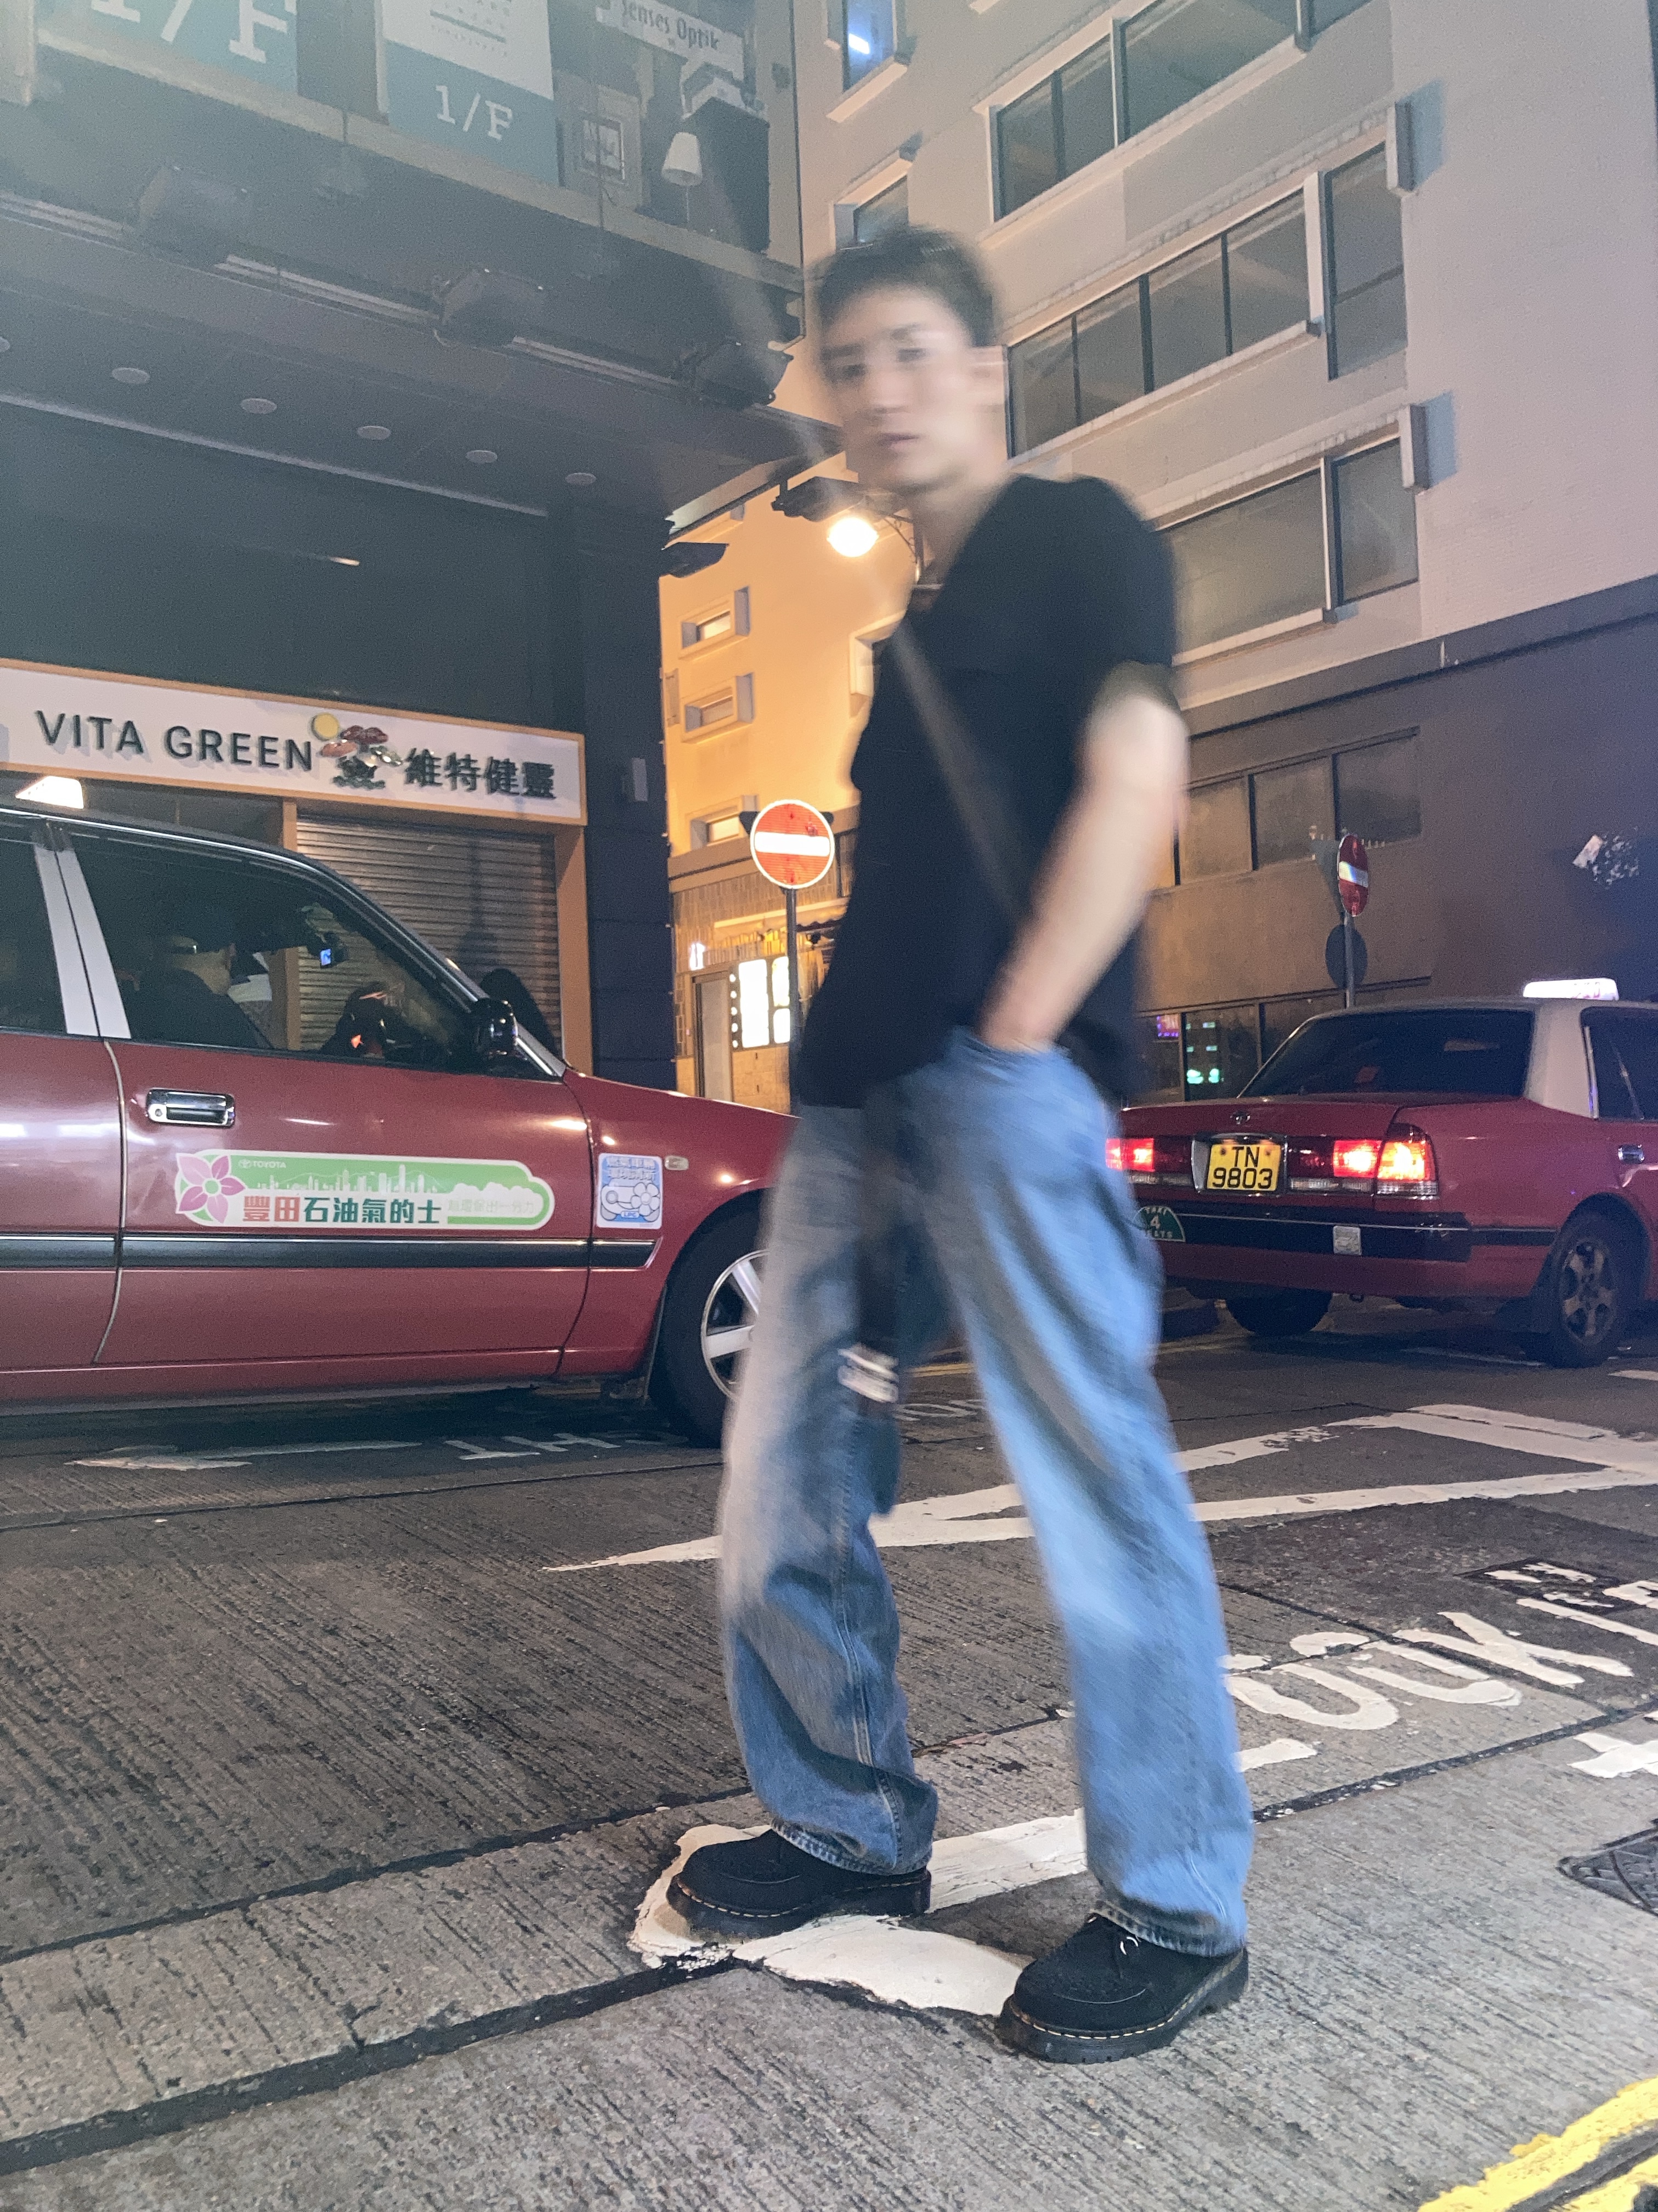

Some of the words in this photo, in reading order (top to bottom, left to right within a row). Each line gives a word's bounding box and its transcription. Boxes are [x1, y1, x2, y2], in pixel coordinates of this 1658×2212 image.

[435, 85, 512, 139] 1/F
[35, 710, 144, 753] VITA
[166, 725, 312, 771] GREEN
[1231, 1146, 1260, 1167] TN
[1212, 1167, 1272, 1189] 9803
[1150, 1214, 1161, 1229] 4
